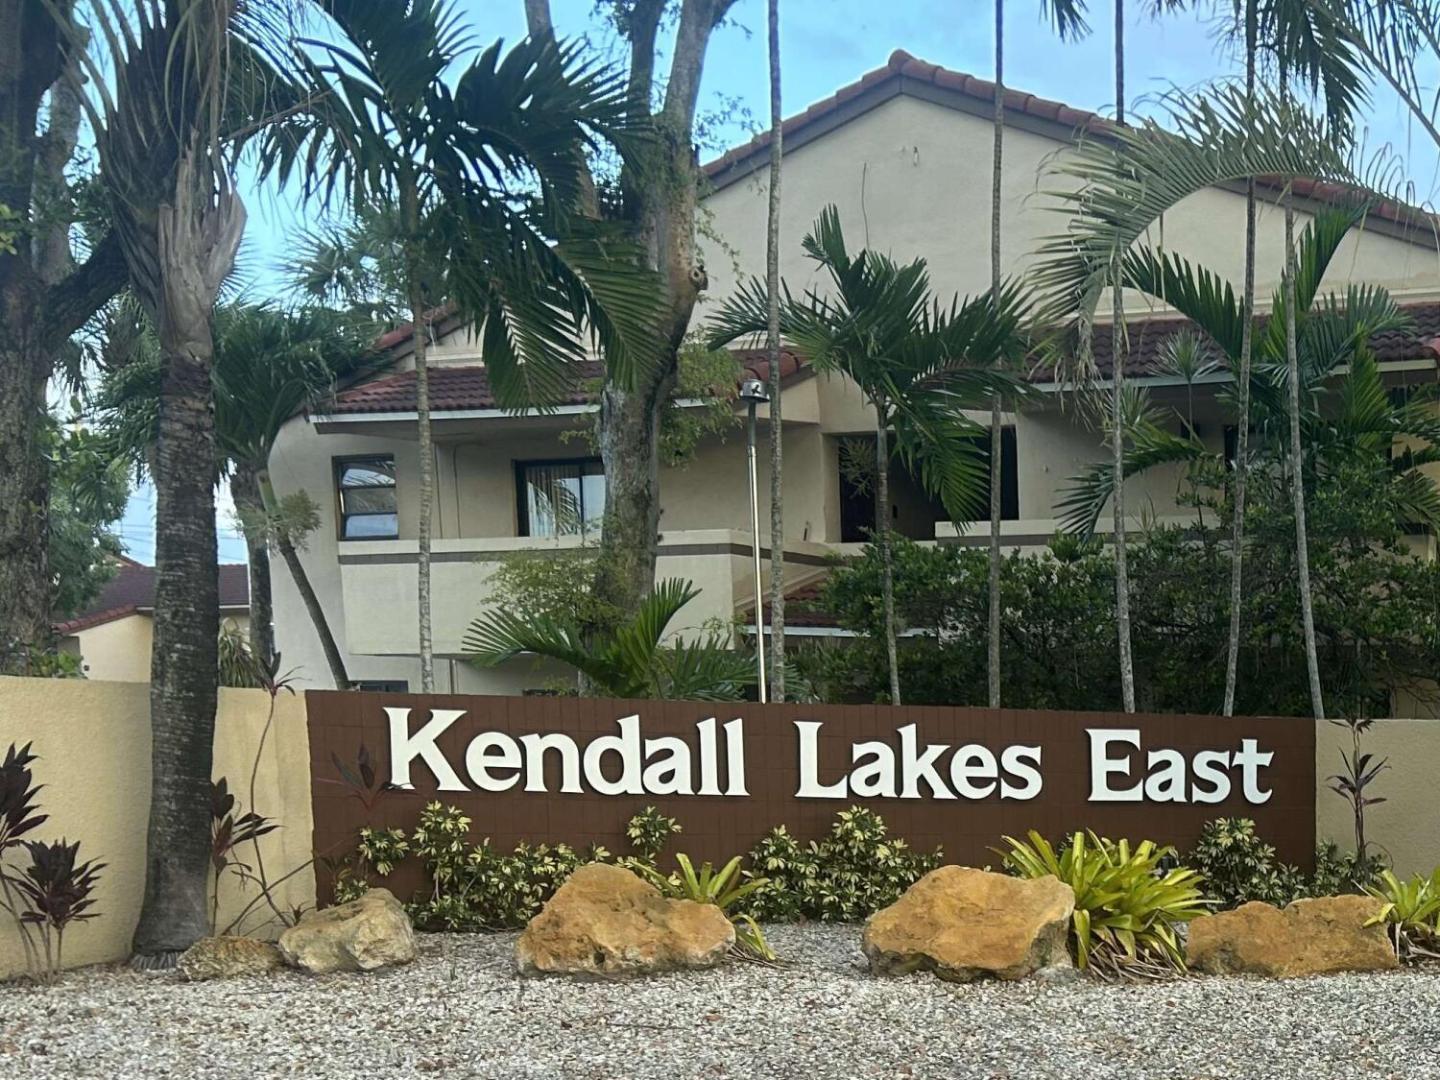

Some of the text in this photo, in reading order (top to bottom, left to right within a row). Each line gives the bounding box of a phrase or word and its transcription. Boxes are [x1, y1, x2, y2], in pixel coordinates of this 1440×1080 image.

[384, 707, 1274, 803] Kendall Lakes East
